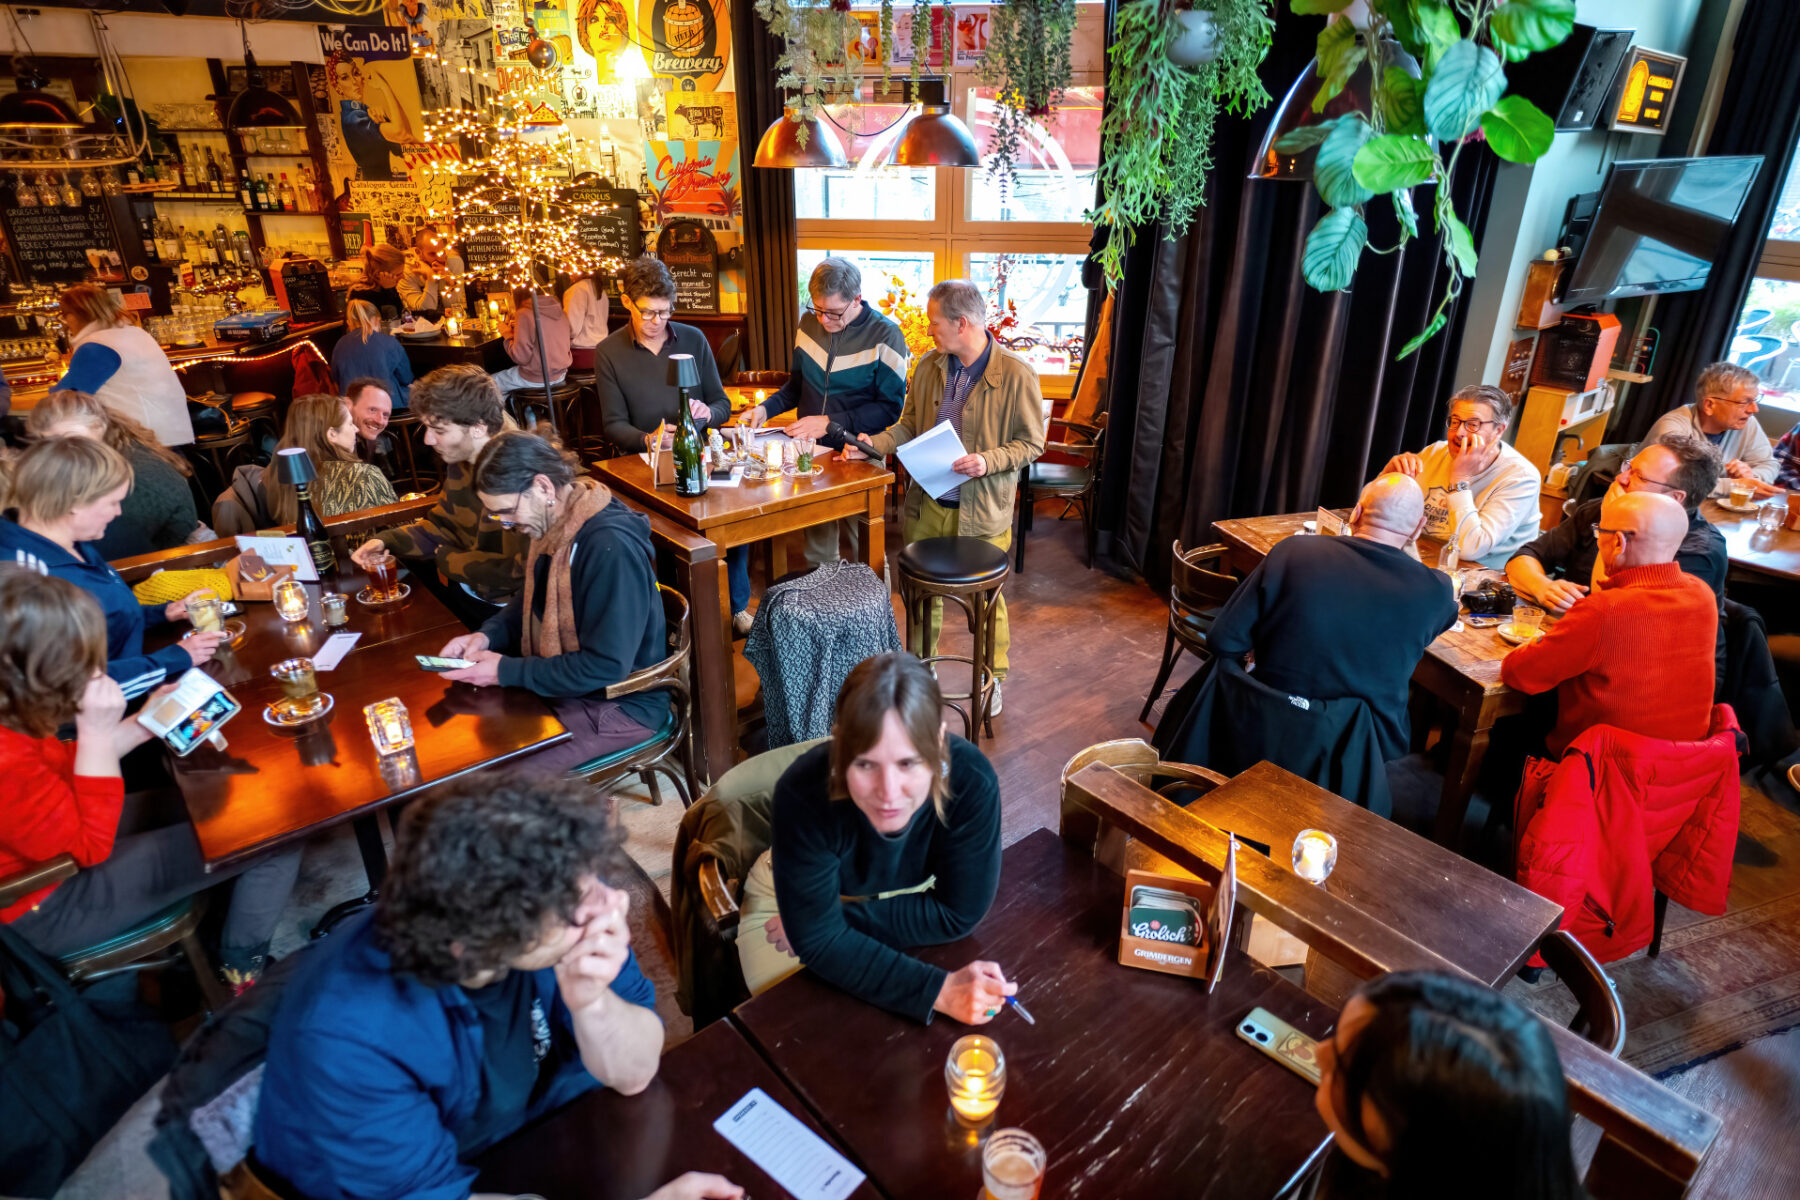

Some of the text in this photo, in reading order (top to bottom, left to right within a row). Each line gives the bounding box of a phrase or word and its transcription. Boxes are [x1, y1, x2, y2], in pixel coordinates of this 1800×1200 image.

[320, 32, 407, 51] We Can Do It!
[653, 52, 722, 73] Brewery
[655, 154, 714, 182] California
[350, 181, 386, 190] Catalogue
[572, 193, 611, 201] CAROLUS
[669, 266, 698, 279] Gerecht
[1132, 921, 1187, 943] Grolsch
[1134, 948, 1192, 965] GRIMBERGEN
